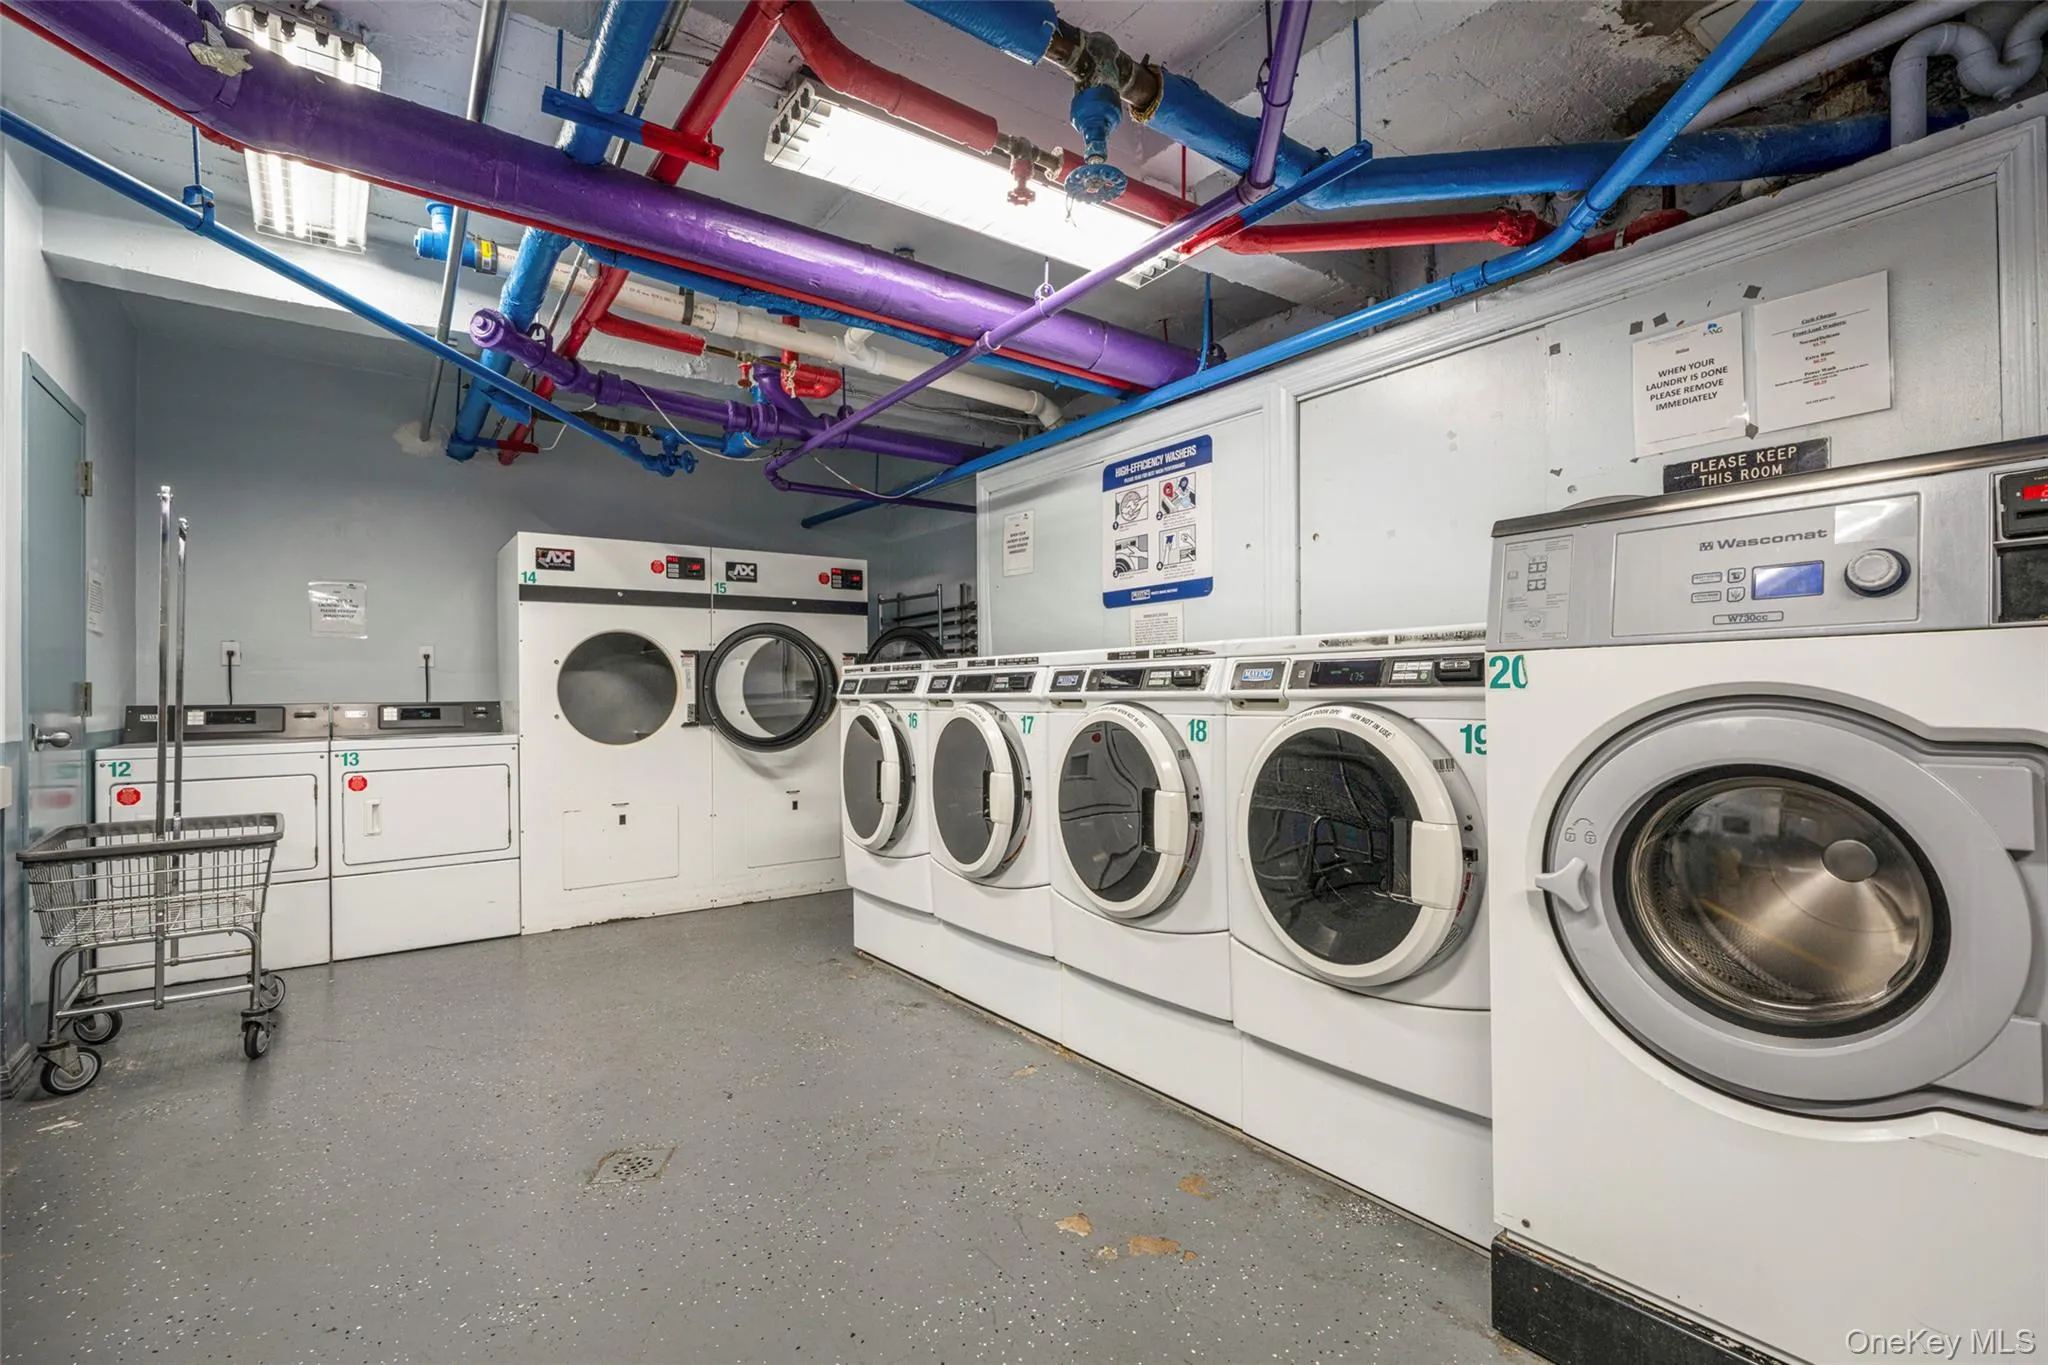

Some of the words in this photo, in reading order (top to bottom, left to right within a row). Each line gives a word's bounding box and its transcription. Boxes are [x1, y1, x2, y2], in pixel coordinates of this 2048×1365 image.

[1657, 364, 1686, 378] WHEN
[1688, 358, 1715, 371] YOUR
[1646, 375, 1688, 392] LAUNDRY
[1690, 372, 1699, 382] IS
[1700, 365, 1729, 379] DONE
[1650, 387, 1681, 402] PLEASE
[1683, 378, 1725, 394] REMOVE
[1655, 391, 1718, 411] IMMEDIATELY
[1115, 454, 1163, 478] HIGH-EFFICIENCY
[1164, 444, 1197, 464] WASHERS
[1691, 454, 1747, 474] PLEASE
[1756, 446, 1797, 464] KEEP
[1699, 471, 1733, 487] THIS
[1740, 464, 1783, 481] ROOM
[1717, 528, 1828, 550] Wascomat
[521, 571, 537, 583] 14
[714, 582, 727, 594] 15
[1728, 614, 1768, 623] W730cc
[1242, 669, 1273, 679] MAYTAG
[1489, 654, 1528, 689] 20
[908, 712, 918, 729] 16
[1313, 708, 1329, 716] DOOR
[1021, 715, 1034, 734] 17
[1188, 718, 1208, 742] 18
[1360, 716, 1374, 728] NOT
[1378, 726, 1393, 739] USE
[1459, 723, 1487, 755] 19
[107, 761, 132, 778] 12
[341, 752, 359, 767] 13
